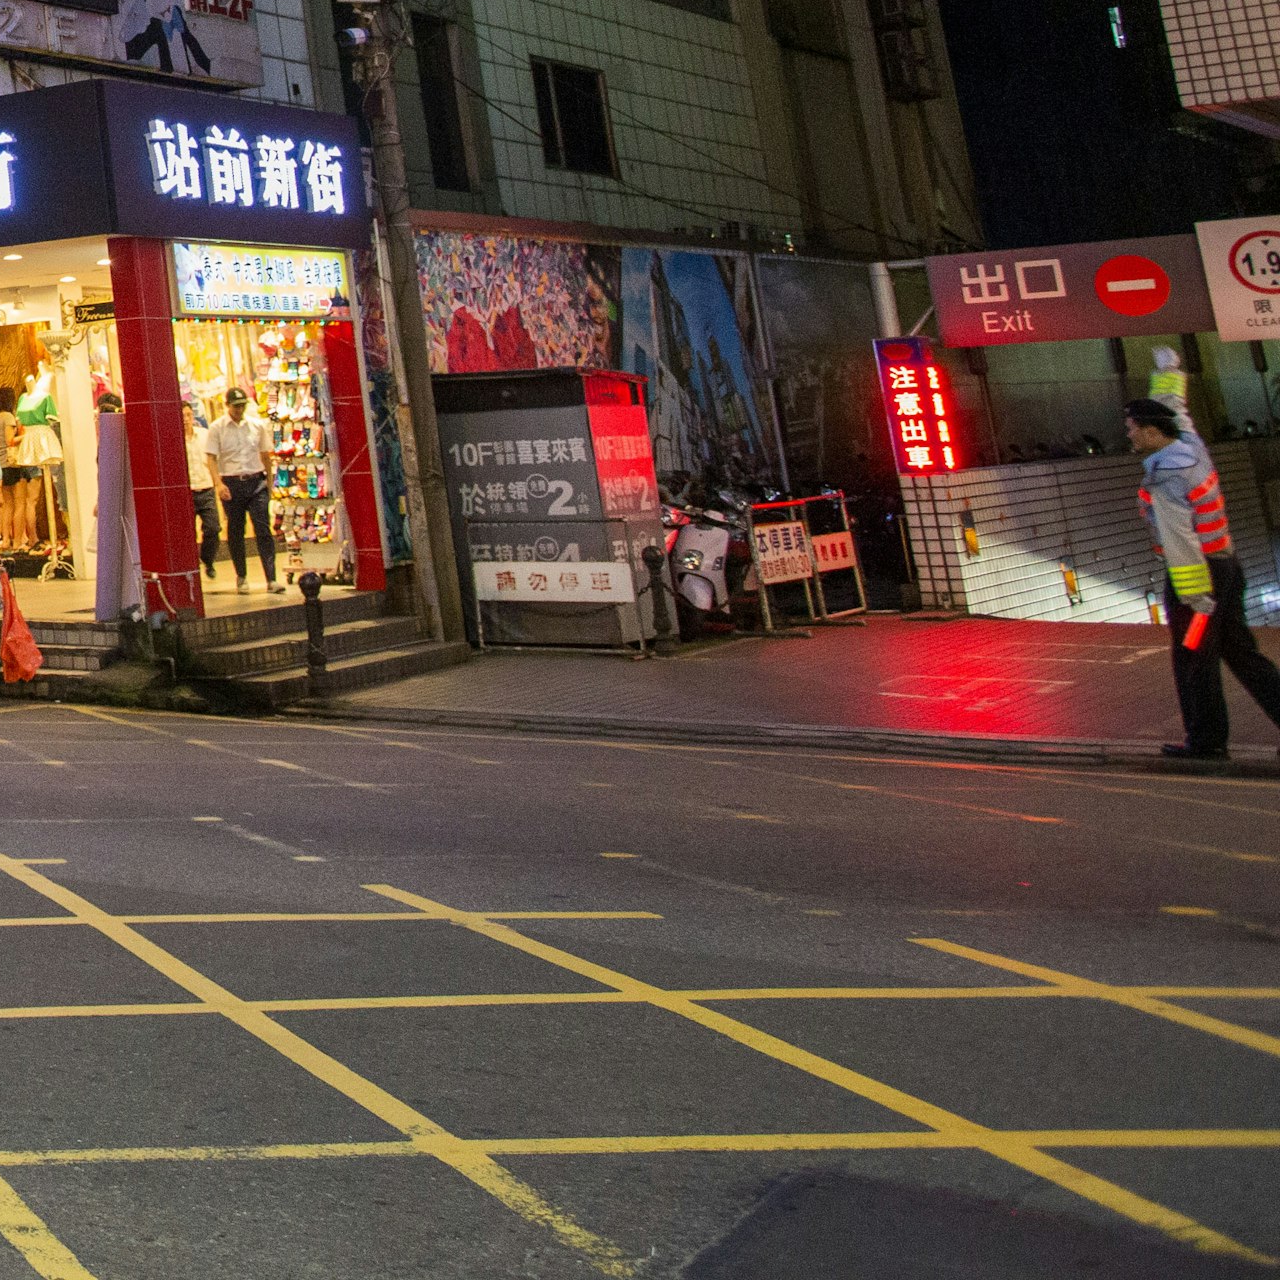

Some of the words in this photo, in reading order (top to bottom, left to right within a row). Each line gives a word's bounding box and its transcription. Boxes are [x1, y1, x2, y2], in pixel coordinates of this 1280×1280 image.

[147, 118, 346, 215] 站前新街
[959, 258, 1068, 305] 出口
[980, 308, 1035, 334] Exit
[889, 366, 934, 470] 注意出車
[448, 442, 493, 467] 10F
[547, 480, 578, 516] 2
[495, 570, 613, 592] 請勿停車
